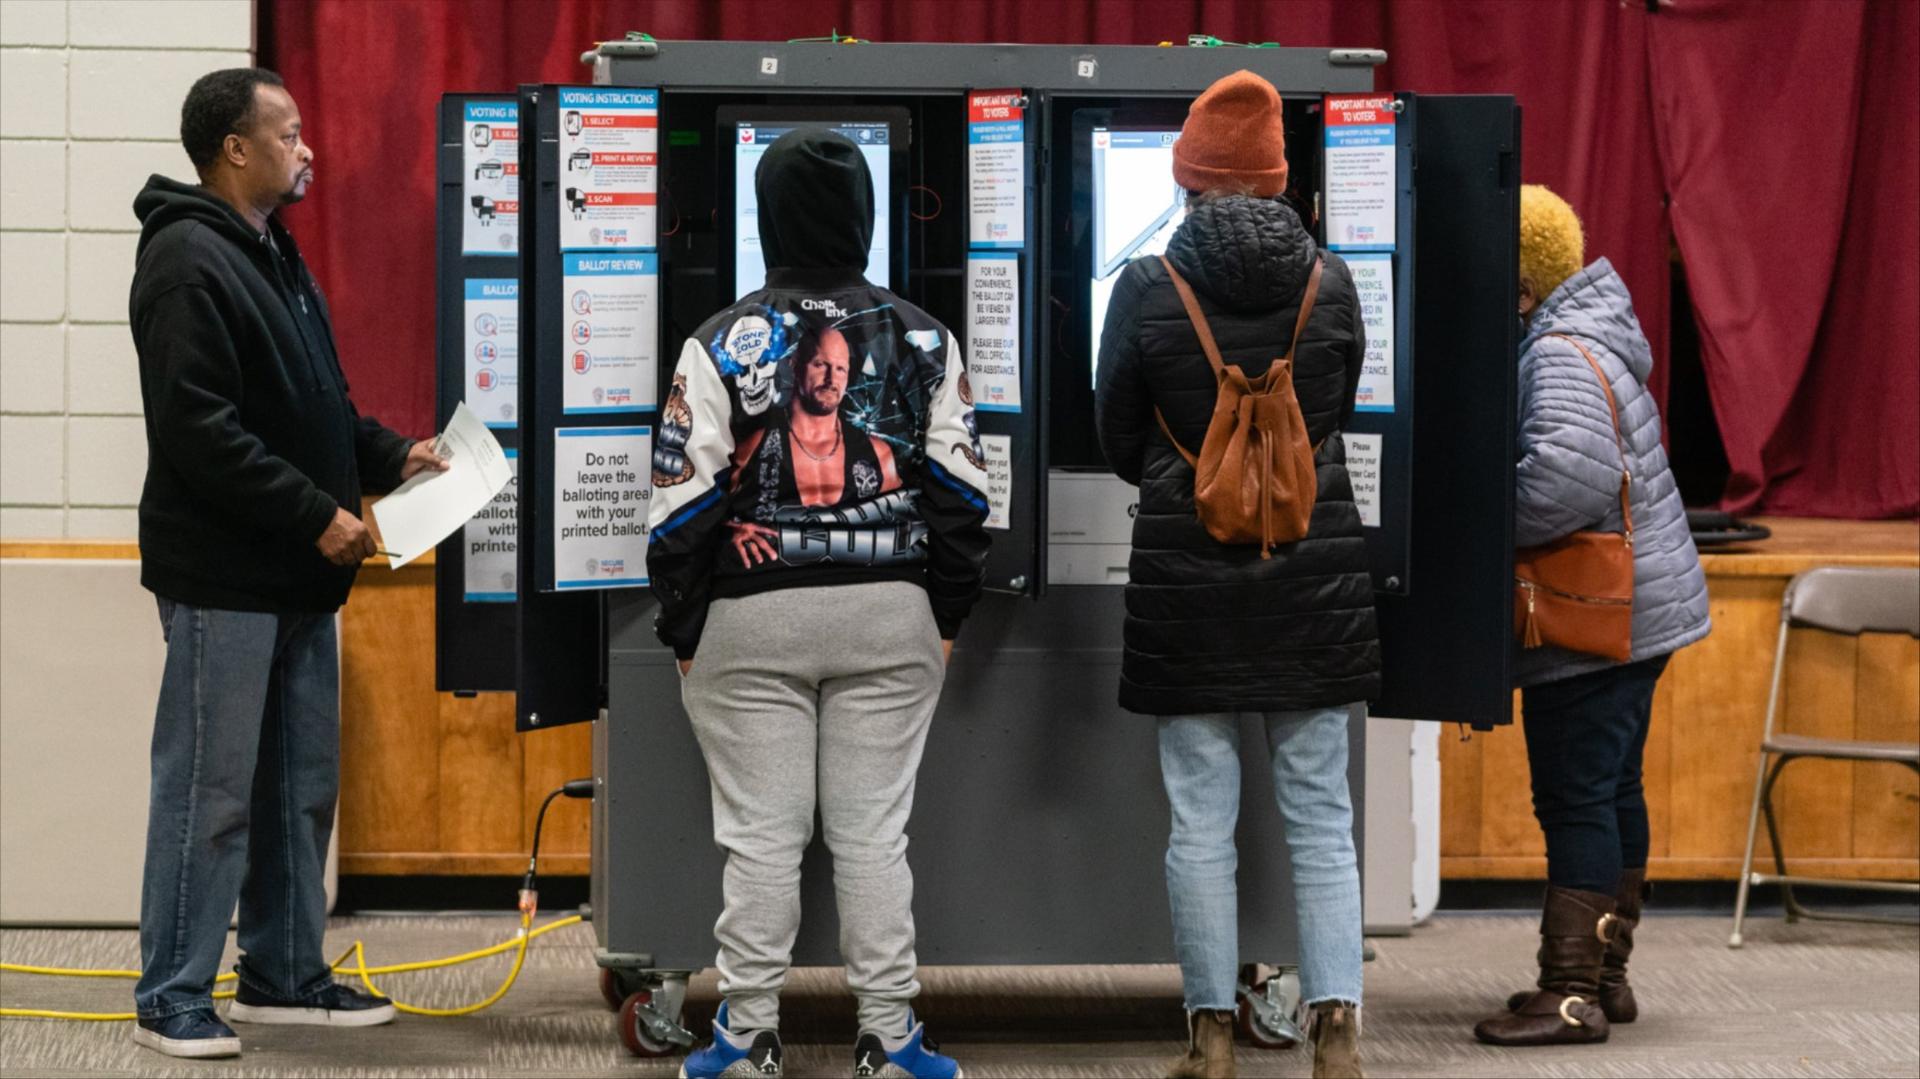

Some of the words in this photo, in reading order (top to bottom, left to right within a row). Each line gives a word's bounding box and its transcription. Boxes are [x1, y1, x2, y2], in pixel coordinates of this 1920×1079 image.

[766, 62, 773, 71] 2
[1083, 65, 1089, 74] 3
[563, 91, 594, 104] VOTING
[595, 92, 654, 105] INSTRUCTIONS
[1330, 99, 1365, 111] IMPORTANT
[469, 107, 506, 118] VOTING
[991, 107, 1010, 117] VOTERS
[1343, 111, 1352, 121] TO
[1353, 110, 1376, 121] VOTERS
[590, 117, 615, 126] SELECT
[601, 154, 619, 163] PRINT
[626, 154, 654, 163] REVIEW
[594, 194, 613, 203] SCAN
[578, 260, 609, 272] BALLOT
[611, 259, 643, 271] REVIEW
[980, 267, 991, 276] FOR
[993, 267, 1007, 276] YOUR
[1358, 268, 1376, 278] YOUR
[972, 291, 983, 300] THE
[984, 291, 1003, 301] BALLOT
[1004, 292, 1014, 301] CAN
[1373, 293, 1388, 302] CAN
[801, 299, 836, 310] Chalk
[976, 303, 984, 313] BE
[985, 303, 1004, 314] VIEWED
[1375, 305, 1383, 315] IN
[975, 315, 995, 325] LARGER
[972, 338, 992, 348] PLEASE
[993, 338, 1002, 348] SEE
[1003, 339, 1014, 348] OUR
[1372, 339, 1388, 349] OUR
[975, 350, 989, 360] POLL
[990, 350, 1012, 361] OFFICIAL
[970, 364, 983, 374] FOR
[1352, 441, 1371, 451] Please
[585, 452, 605, 466] Do
[608, 452, 629, 466] not
[1365, 457, 1377, 467] your
[577, 470, 613, 484] leave
[616, 469, 636, 483] the
[1363, 470, 1377, 479] Card
[1354, 483, 1364, 492] the
[1364, 483, 1376, 493] Poll
[562, 487, 620, 505] balloting
[622, 488, 649, 501] area
[576, 505, 605, 519] with
[608, 506, 636, 522] your
[488, 522, 518, 536] with
[561, 523, 609, 540] printed
[612, 521, 649, 536] ballot.
